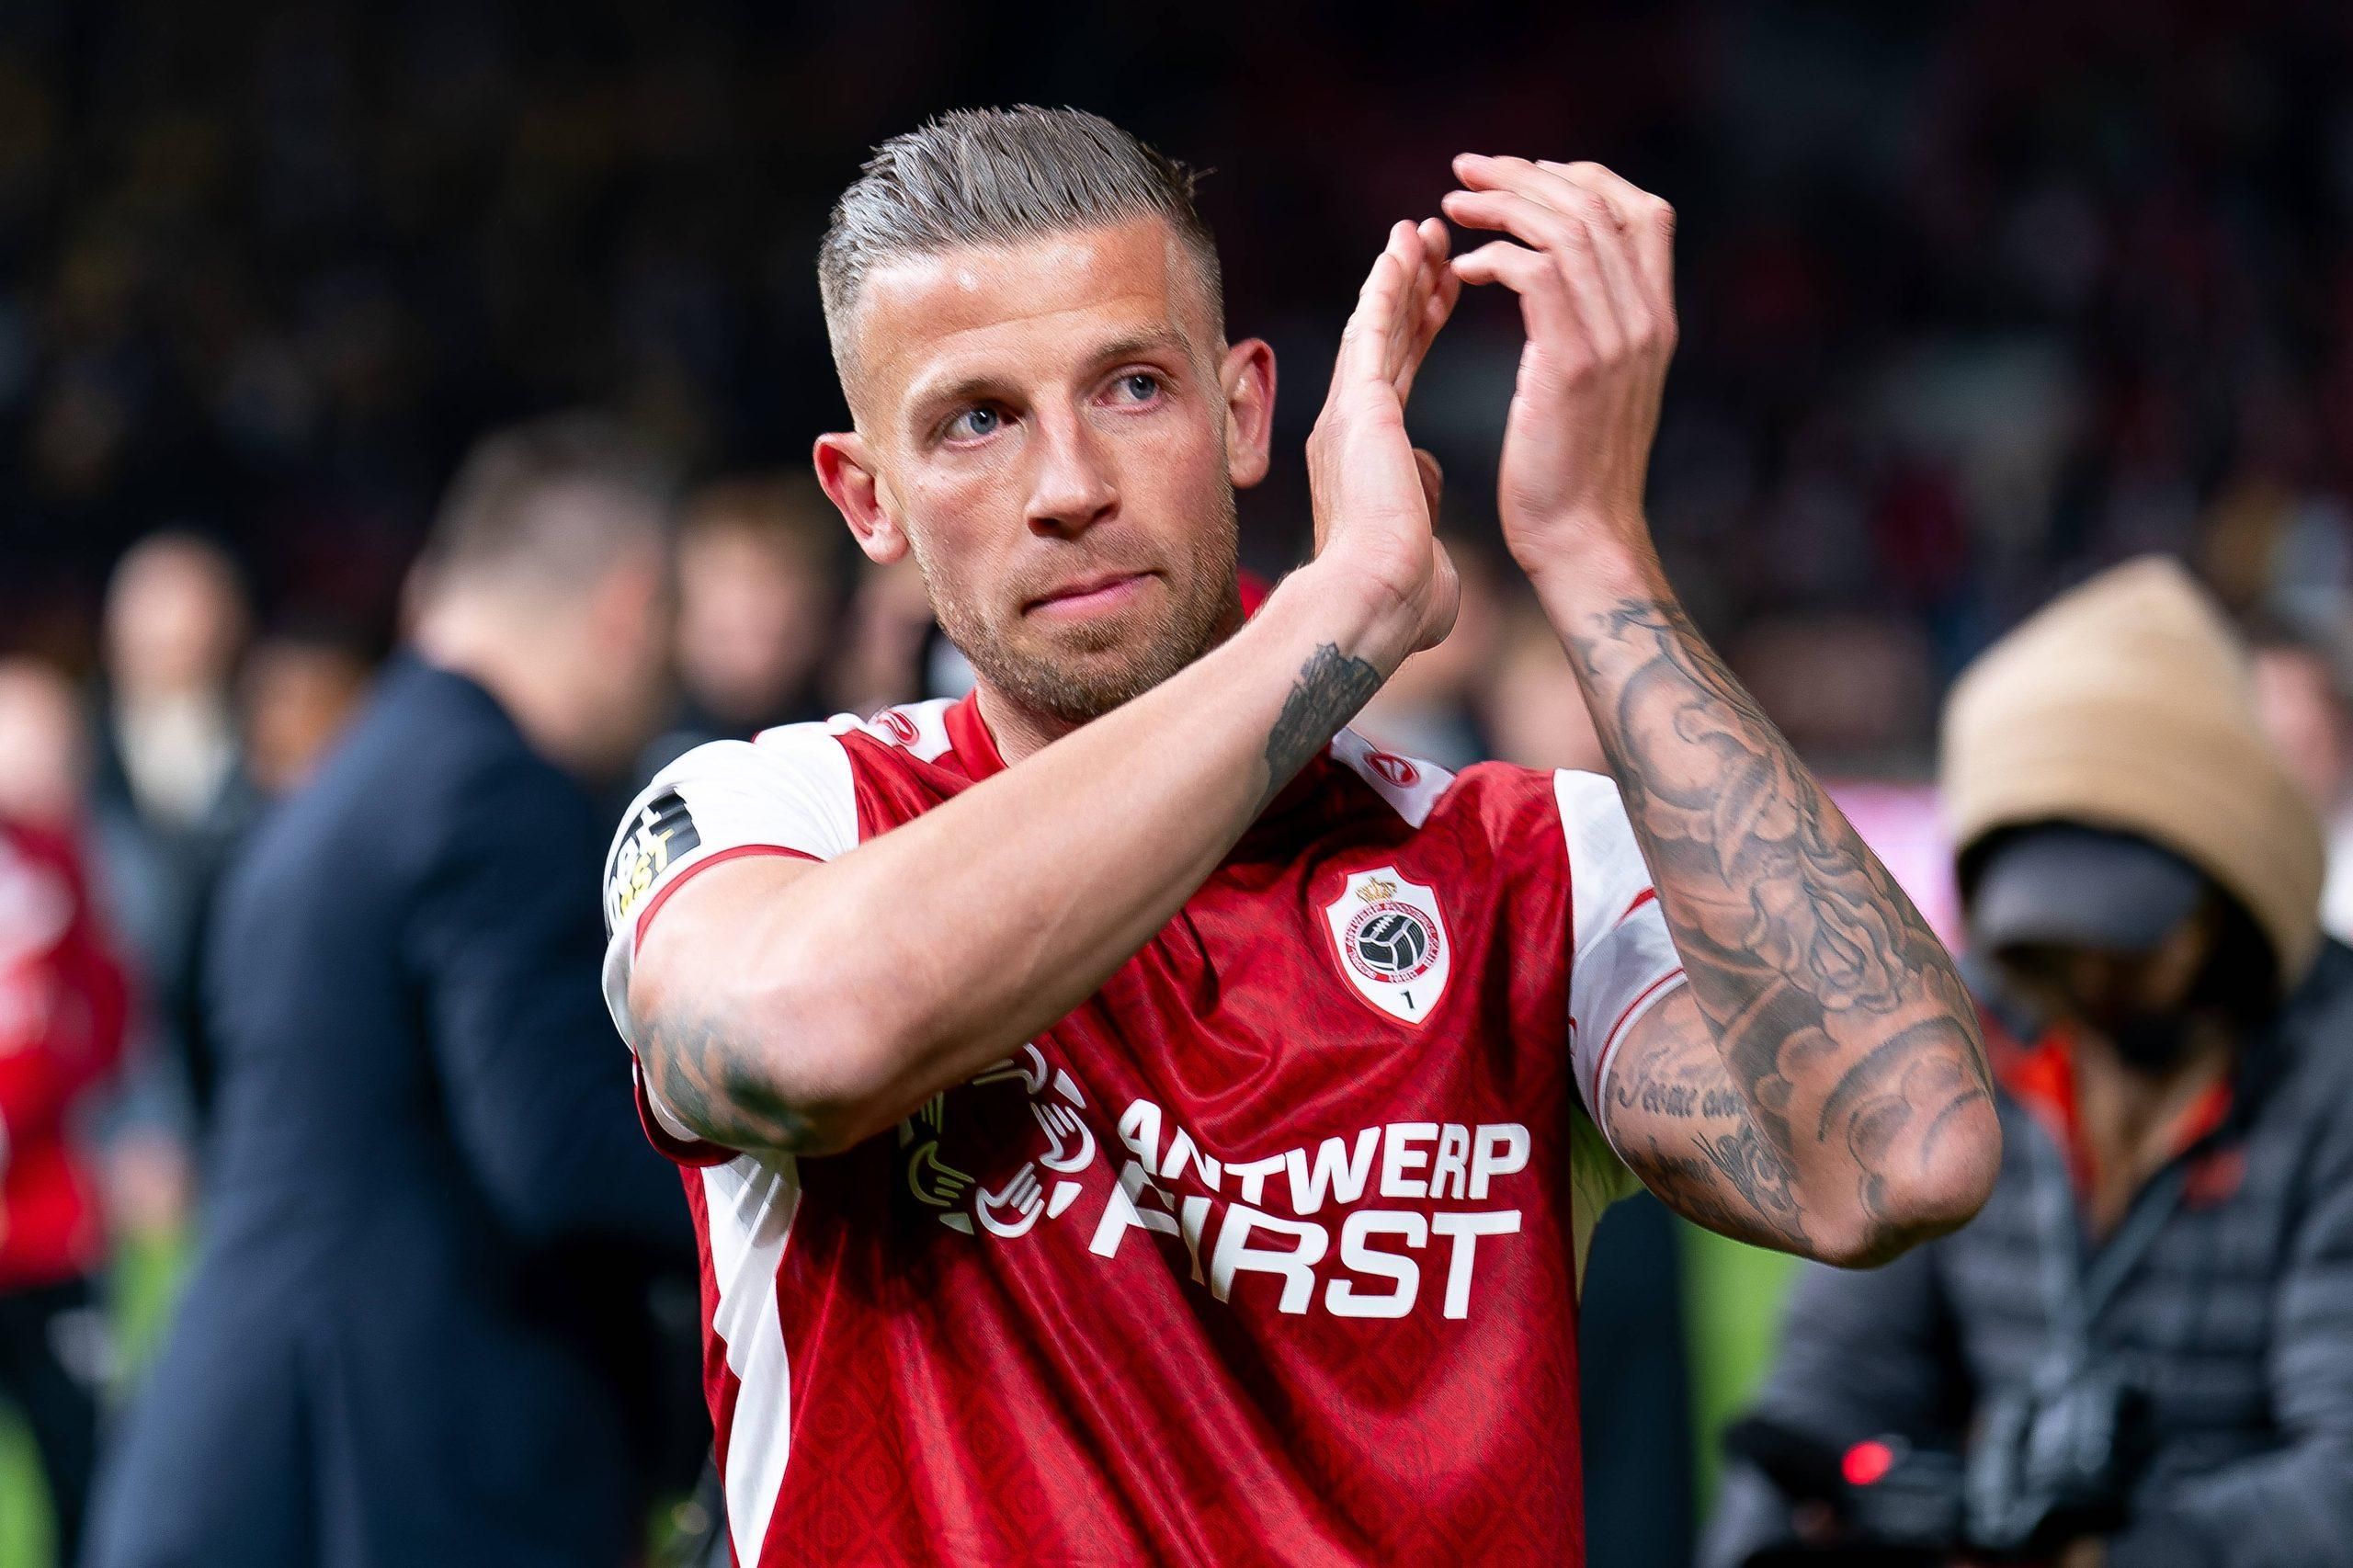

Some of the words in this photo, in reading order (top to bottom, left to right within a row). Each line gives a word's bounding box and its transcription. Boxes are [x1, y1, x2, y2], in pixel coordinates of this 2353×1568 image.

[1400, 989, 1415, 1010] 1
[1116, 1098, 1531, 1215] ANTWERP
[1087, 1160, 1522, 1320] FIRST
